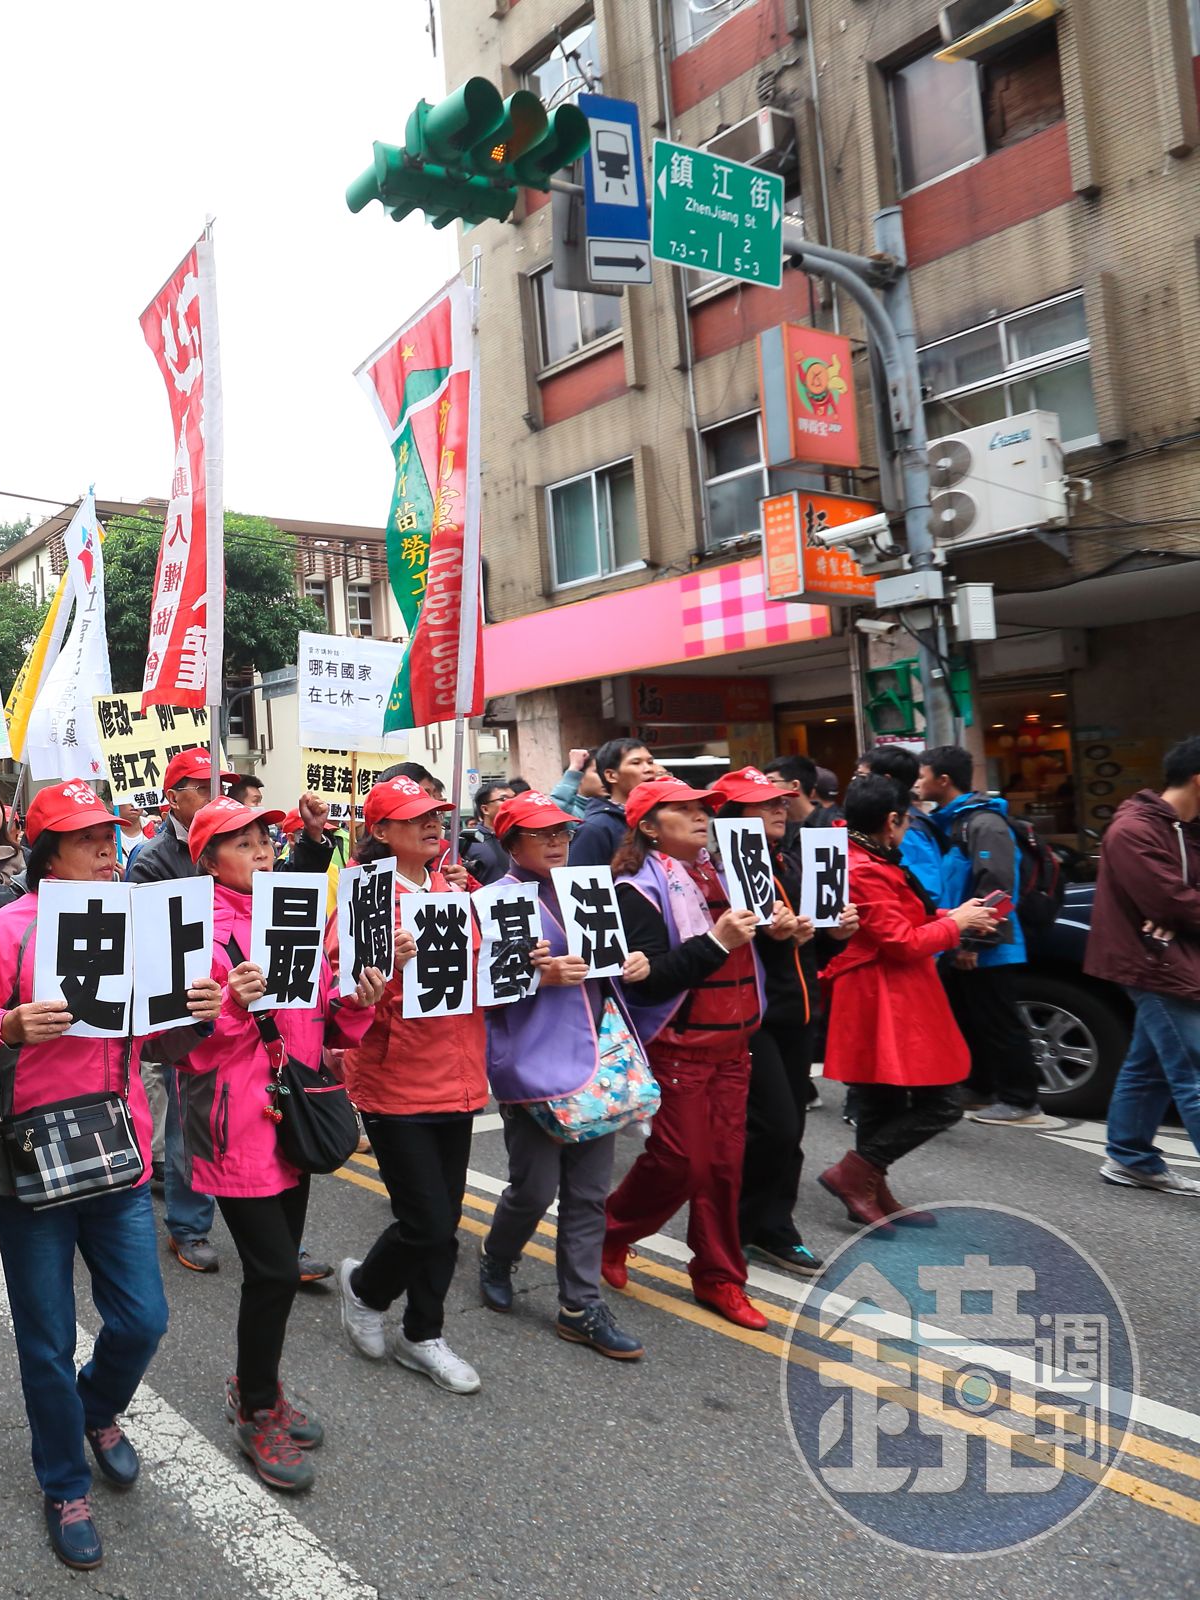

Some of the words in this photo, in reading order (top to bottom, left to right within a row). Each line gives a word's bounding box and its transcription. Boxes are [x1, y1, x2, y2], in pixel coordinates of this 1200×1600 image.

[670, 152, 771, 211] 鎮江街
[685, 197, 739, 228] ZhenJiang
[743, 239, 752, 253] 2
[308, 659, 372, 681] 哪有國家
[308, 686, 384, 708] 在七休一？
[108, 749, 161, 792] 勞工不
[306, 763, 352, 795] 勞基法
[326, 803, 365, 819] 動人權
[731, 828, 777, 918] 修
[815, 845, 846, 919] 改
[264, 887, 322, 1004] 最
[348, 870, 394, 984] 爛
[414, 903, 469, 1013] 勞
[490, 896, 538, 1000] 基
[570, 878, 626, 969] 法
[56, 899, 127, 1031] 史
[148, 896, 205, 1026] 上
